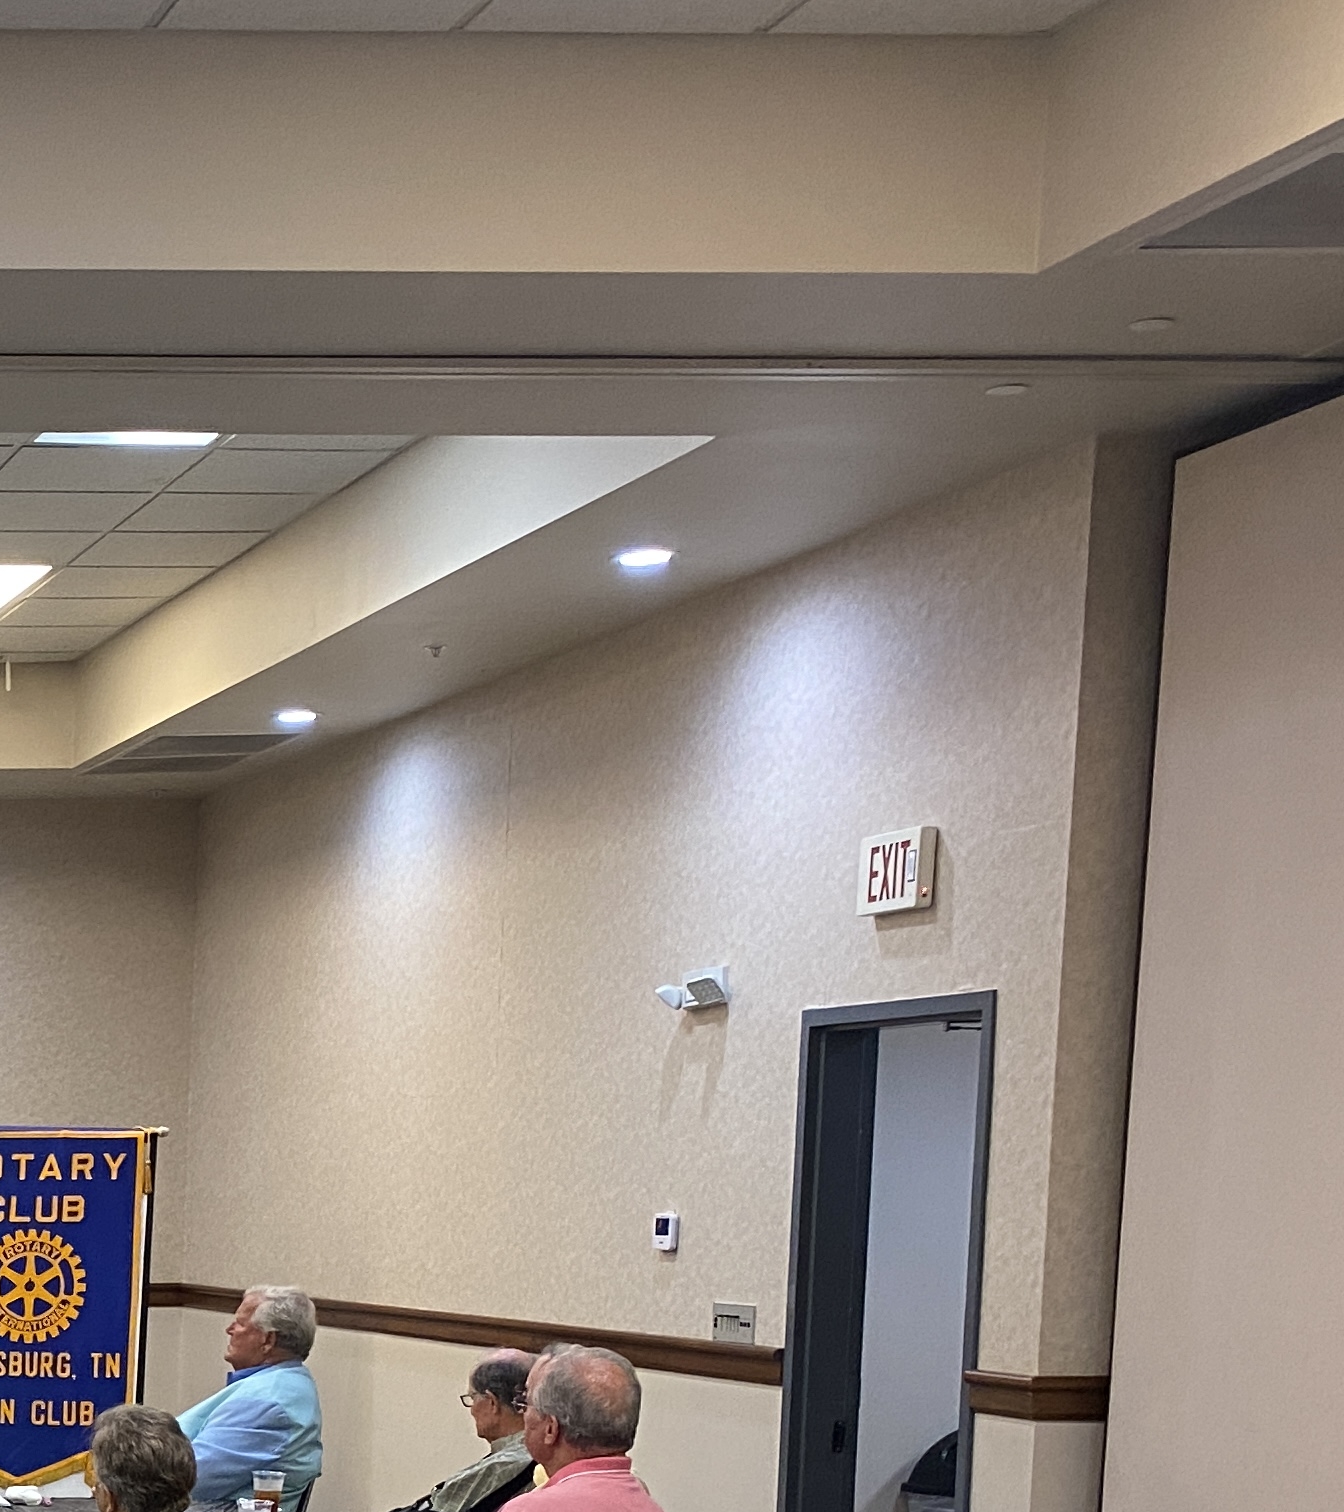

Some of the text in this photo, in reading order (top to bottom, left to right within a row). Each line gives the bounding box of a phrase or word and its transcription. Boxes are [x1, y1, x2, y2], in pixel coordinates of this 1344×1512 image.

[866, 839, 912, 903] EXIT
[4, 1241, 61, 1259] ROTARY
[91, 1352, 121, 1379] TN
[30, 1400, 95, 1426] CLUB
